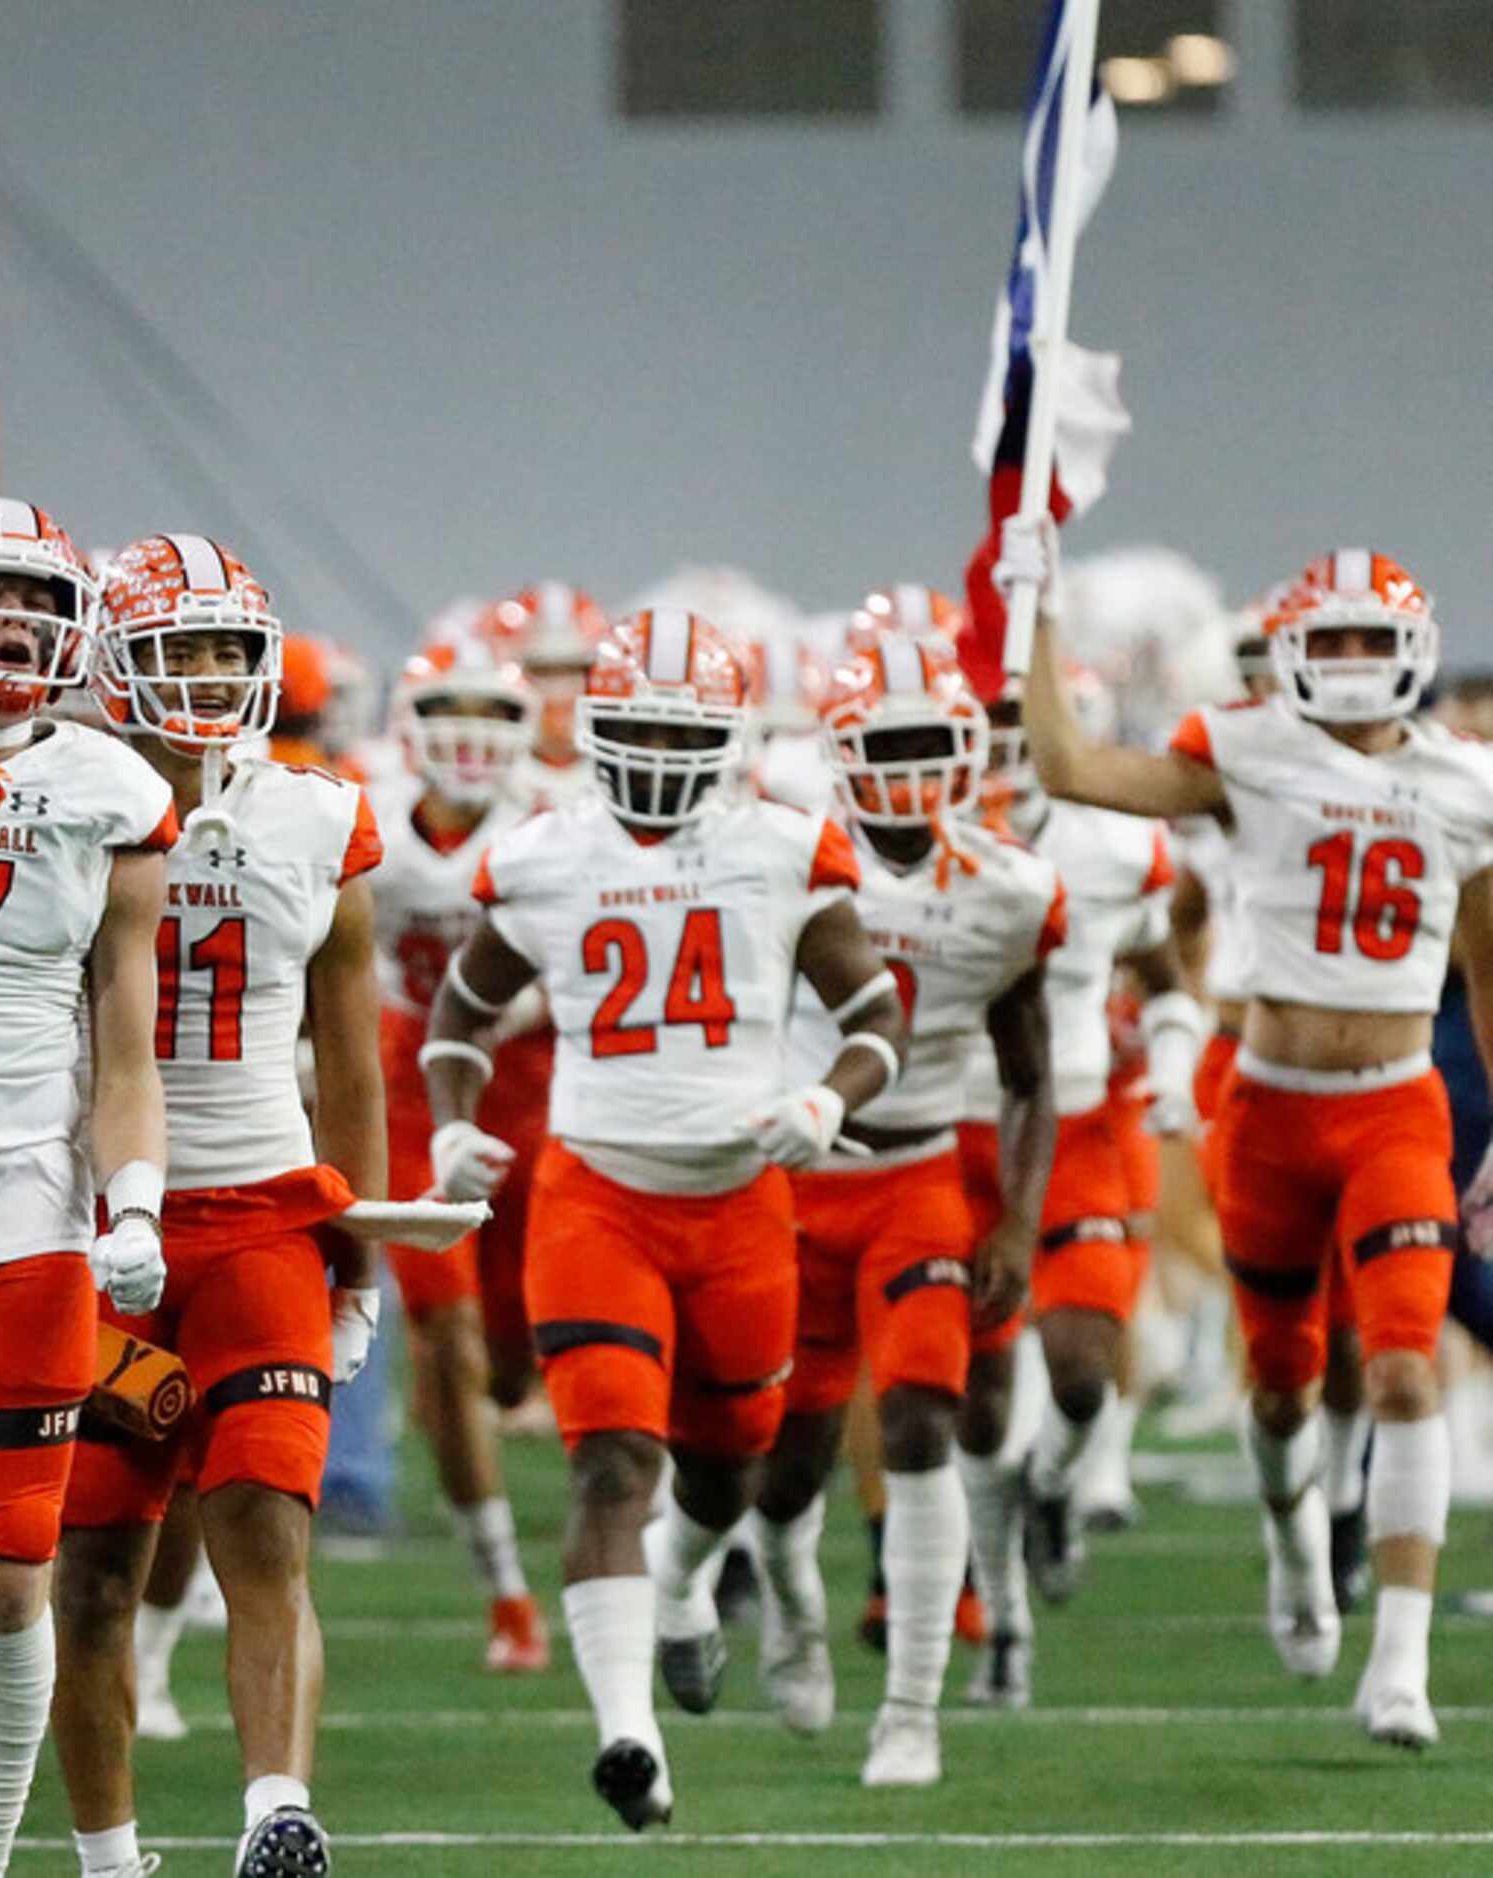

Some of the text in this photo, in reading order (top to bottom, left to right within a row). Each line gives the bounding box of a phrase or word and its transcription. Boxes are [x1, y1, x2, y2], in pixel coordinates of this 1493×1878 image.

[169, 883, 242, 907] KWALL
[1307, 829, 1427, 963] 16
[155, 916, 246, 1061] 11
[582, 907, 737, 1060] 24
